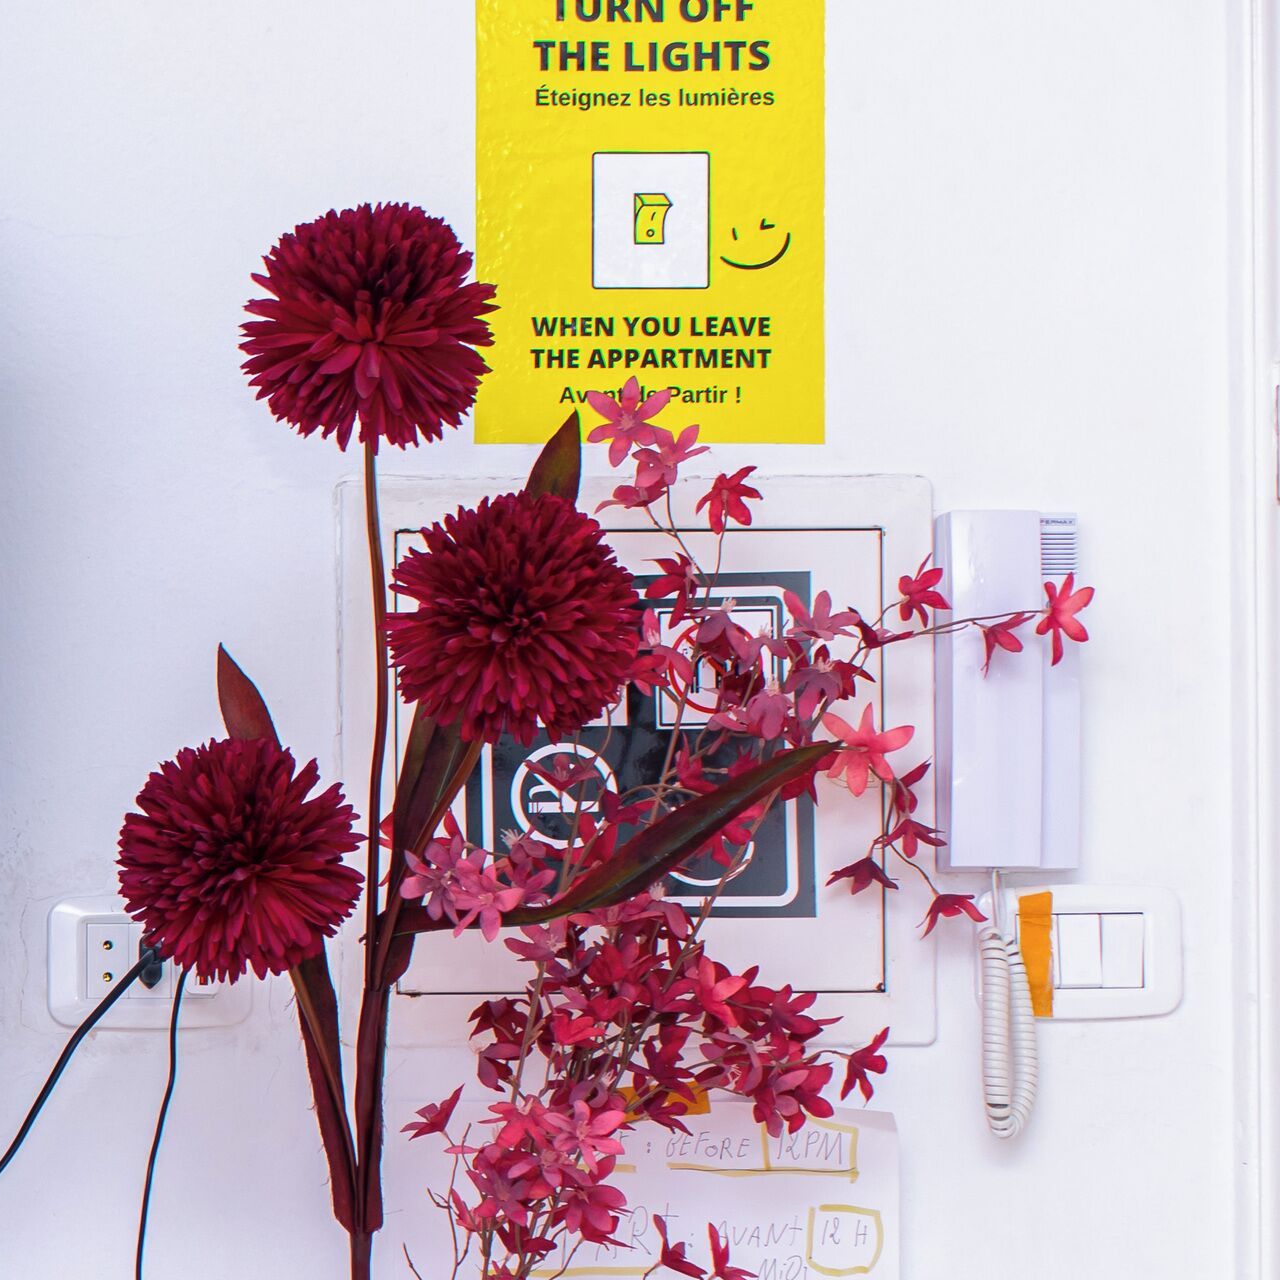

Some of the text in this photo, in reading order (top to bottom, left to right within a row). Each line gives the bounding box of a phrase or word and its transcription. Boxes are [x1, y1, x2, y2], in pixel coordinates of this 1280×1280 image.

[679, 0, 753, 22] OFF
[533, 40, 771, 72] THE LIGHTS
[535, 84, 774, 110] Éteignez les lumières
[531, 316, 772, 337] WHEN YOU LEAVE
[530, 348, 772, 369] THE APPARTMENT
[559, 386, 624, 403] Avnt
[670, 386, 728, 403] Partir
[666, 1130, 753, 1160] BEFORE
